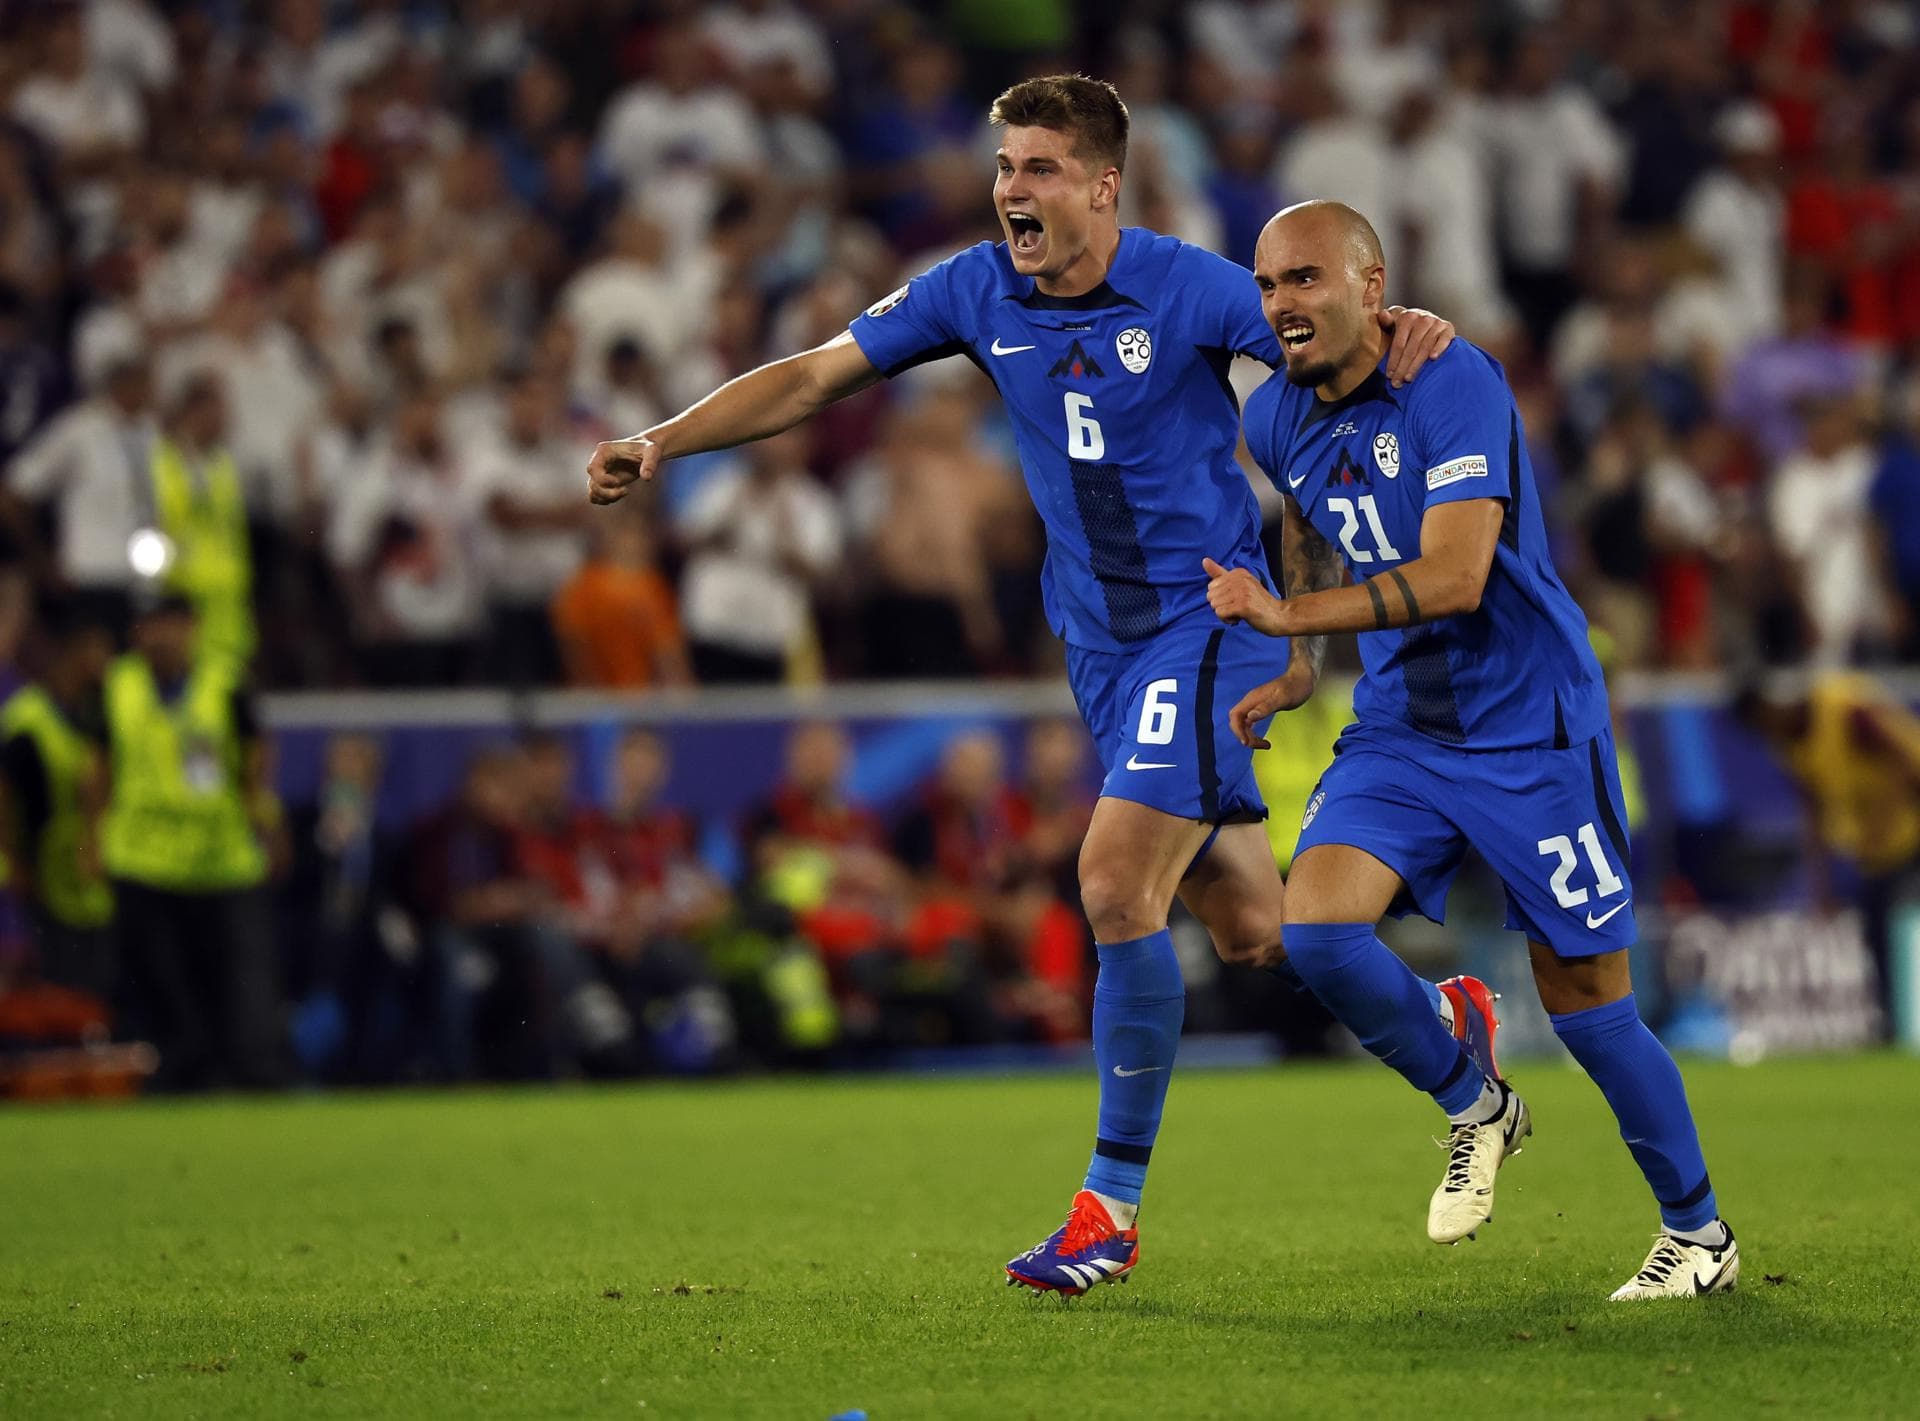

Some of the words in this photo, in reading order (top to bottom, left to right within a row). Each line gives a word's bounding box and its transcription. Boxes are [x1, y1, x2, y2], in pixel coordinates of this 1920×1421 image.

[1064, 391, 1105, 460] 6
[1428, 462, 1486, 482] FOUNDATION
[1327, 494, 1402, 563] 21
[1137, 678, 1178, 745] 6
[1537, 822, 1624, 909] 21
